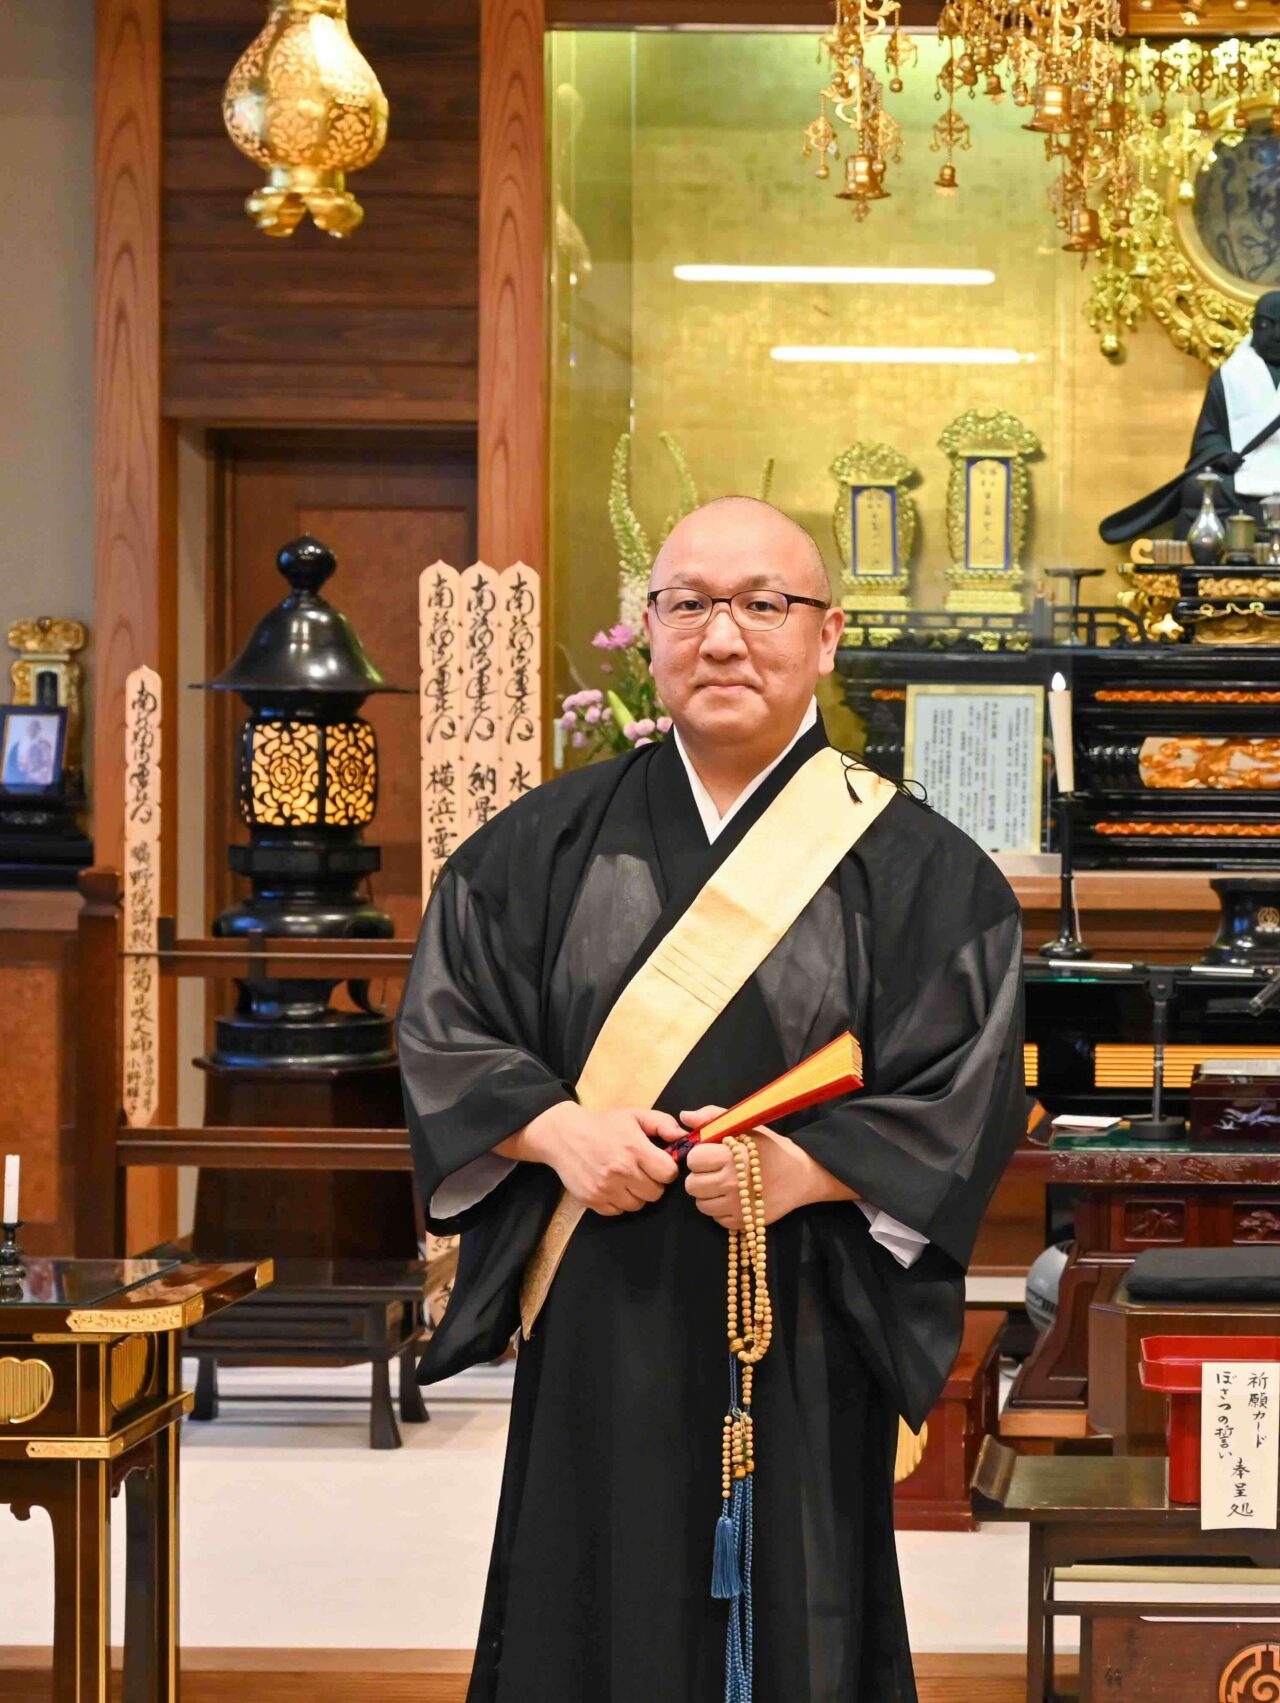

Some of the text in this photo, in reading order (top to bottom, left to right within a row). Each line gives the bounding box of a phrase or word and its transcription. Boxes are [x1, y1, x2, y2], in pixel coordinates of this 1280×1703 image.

[1214, 1371, 1237, 1460] ぼさつの誓い
[1247, 1371, 1269, 1449] 祈願カード
[1226, 1457, 1254, 1518] 奉呈処
